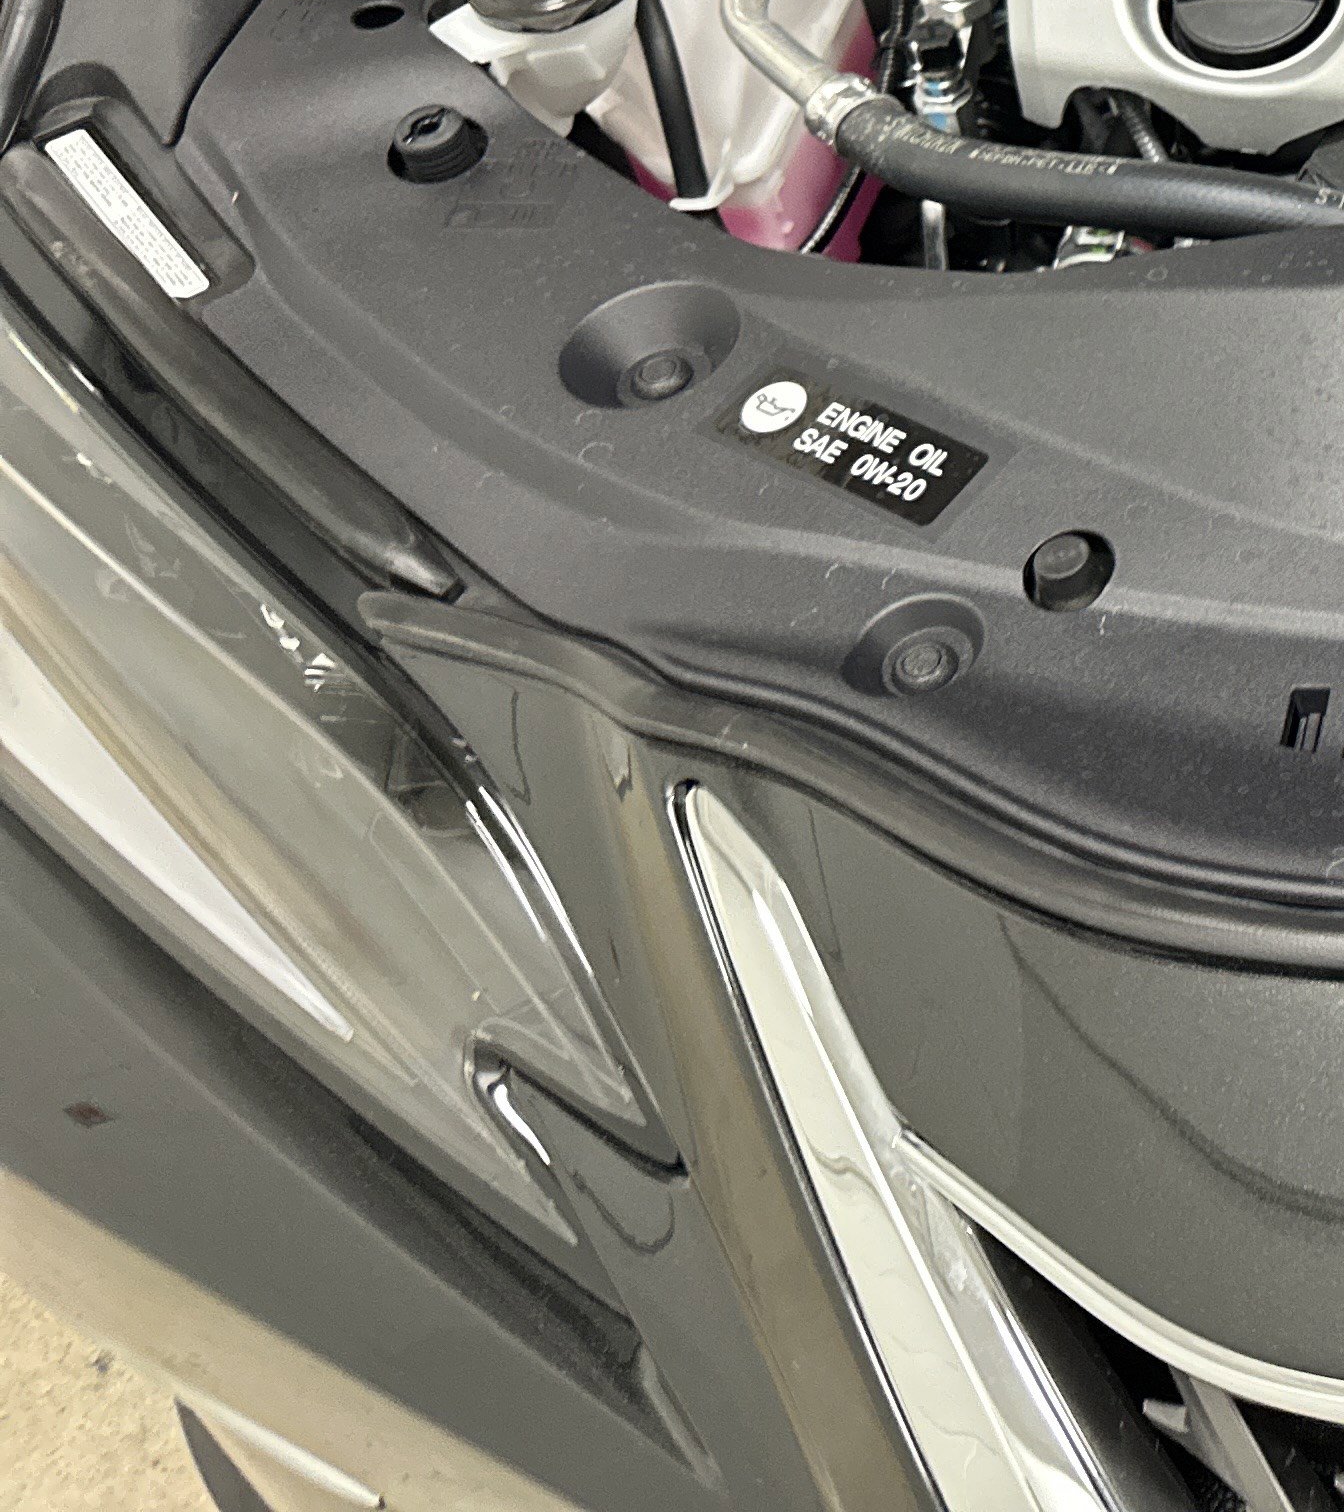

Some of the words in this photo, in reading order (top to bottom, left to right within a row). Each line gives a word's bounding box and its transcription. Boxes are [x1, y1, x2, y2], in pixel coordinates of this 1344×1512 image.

[793, 428, 848, 464] SAE
[851, 454, 928, 502] 0W-20
[816, 402, 907, 453] ENGINE
[908, 443, 948, 477] OIL
